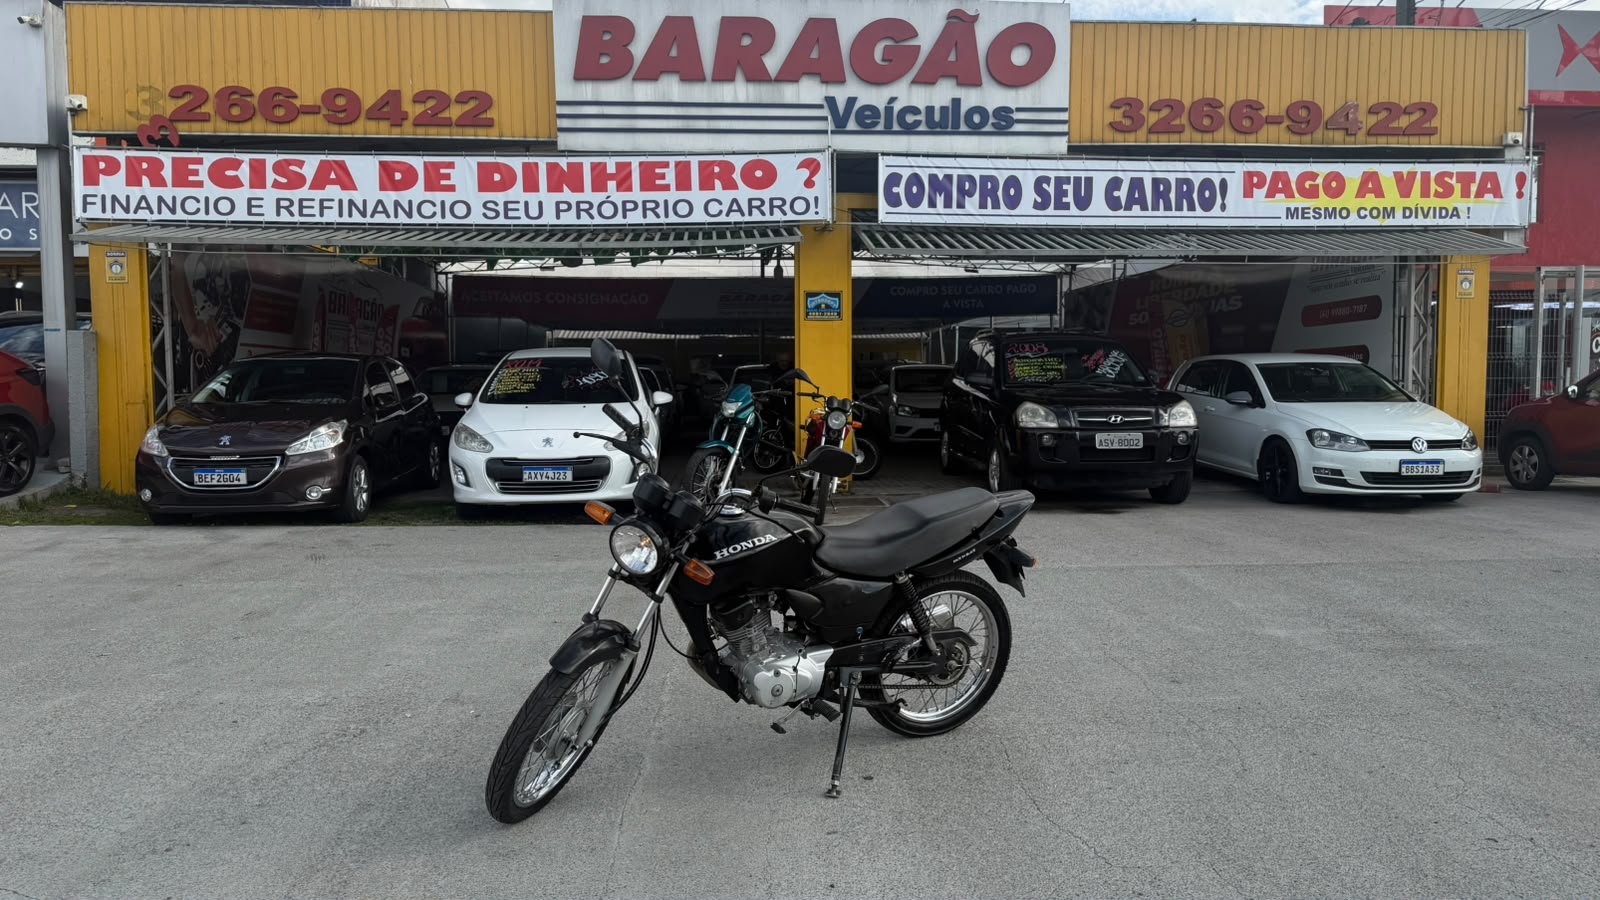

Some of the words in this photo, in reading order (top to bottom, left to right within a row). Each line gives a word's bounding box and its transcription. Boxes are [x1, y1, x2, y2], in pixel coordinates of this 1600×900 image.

[573, 8, 1057, 89] BARAGÃO
[824, 96, 1016, 131] Veículos
[1110, 97, 1438, 136] 3266-9422
[82, 155, 358, 192] PRECISA
[378, 160, 457, 193] DE
[477, 157, 778, 193] DINHEIRO
[1242, 169, 1347, 200] PAGO
[1354, 170, 1386, 200] A
[1391, 170, 1504, 200] VISTA
[883, 171, 1023, 211] COMPRO
[1033, 174, 1094, 212] SEU
[1104, 176, 1229, 212] CARRO!
[82, 193, 237, 216] FINANCIO
[247, 197, 265, 217] E
[275, 197, 473, 220] REFINANCIO
[481, 200, 545, 221] SEU
[555, 195, 692, 221] PRÓPRIO
[702, 196, 820, 219] CARRO!
[1285, 206, 1351, 221] MESMO
[1356, 206, 1397, 221] COM
[1401, 202, 1462, 221] DÍVIDA
[461, 289, 542, 305] ACEITAMOS
[548, 290, 649, 309] CONSIGNAÇÃO
[889, 286, 938, 297] COMPRO
[941, 285, 963, 296] SEU
[965, 284, 1003, 296] CARRO
[1006, 283, 1037, 294] PAGO
[943, 300, 951, 309] A
[954, 299, 984, 310] VISTA
[197, 473, 241, 483] BEF2G04
[527, 471, 568, 481] AXY4J23
[1405, 465, 1440, 474] BBS1A33
[714, 534, 777, 560] HONDA
